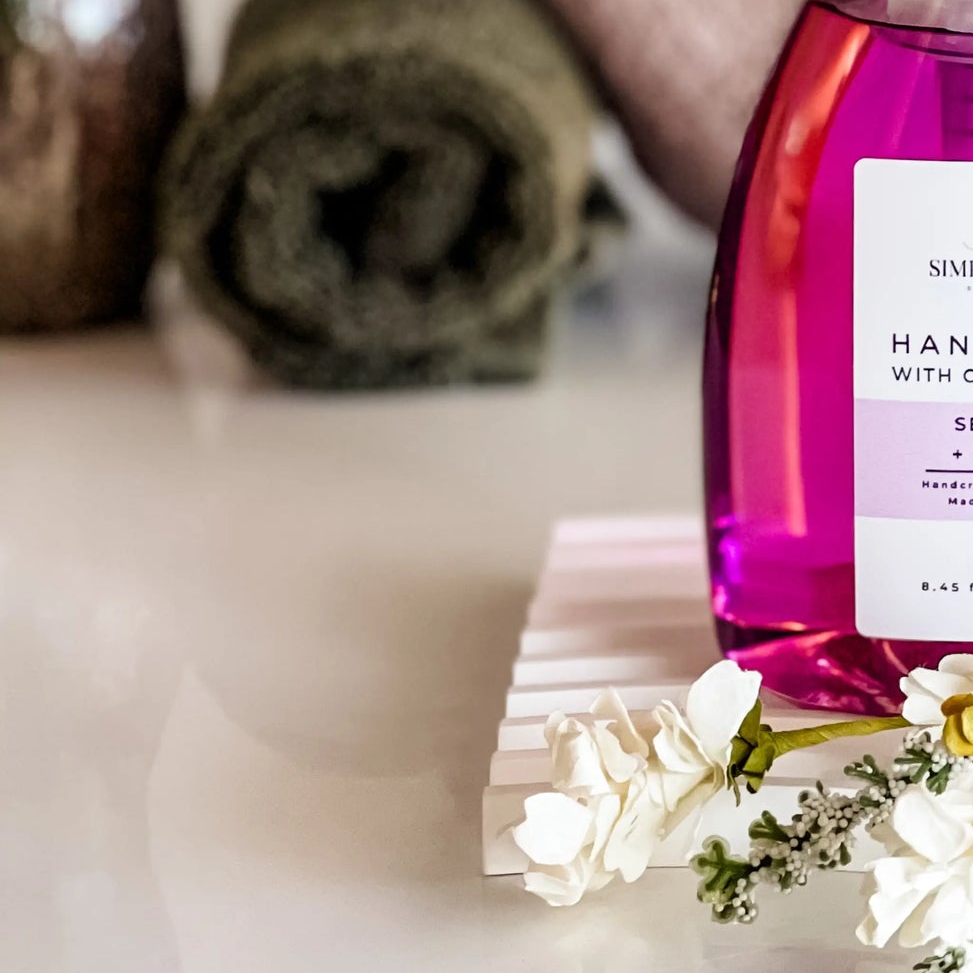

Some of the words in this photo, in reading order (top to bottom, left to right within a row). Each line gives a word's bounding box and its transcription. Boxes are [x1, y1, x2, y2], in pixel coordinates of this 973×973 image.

[892, 366, 951, 383] WITH
[952, 449, 963, 460] +
[921, 581, 960, 593] 8.45
